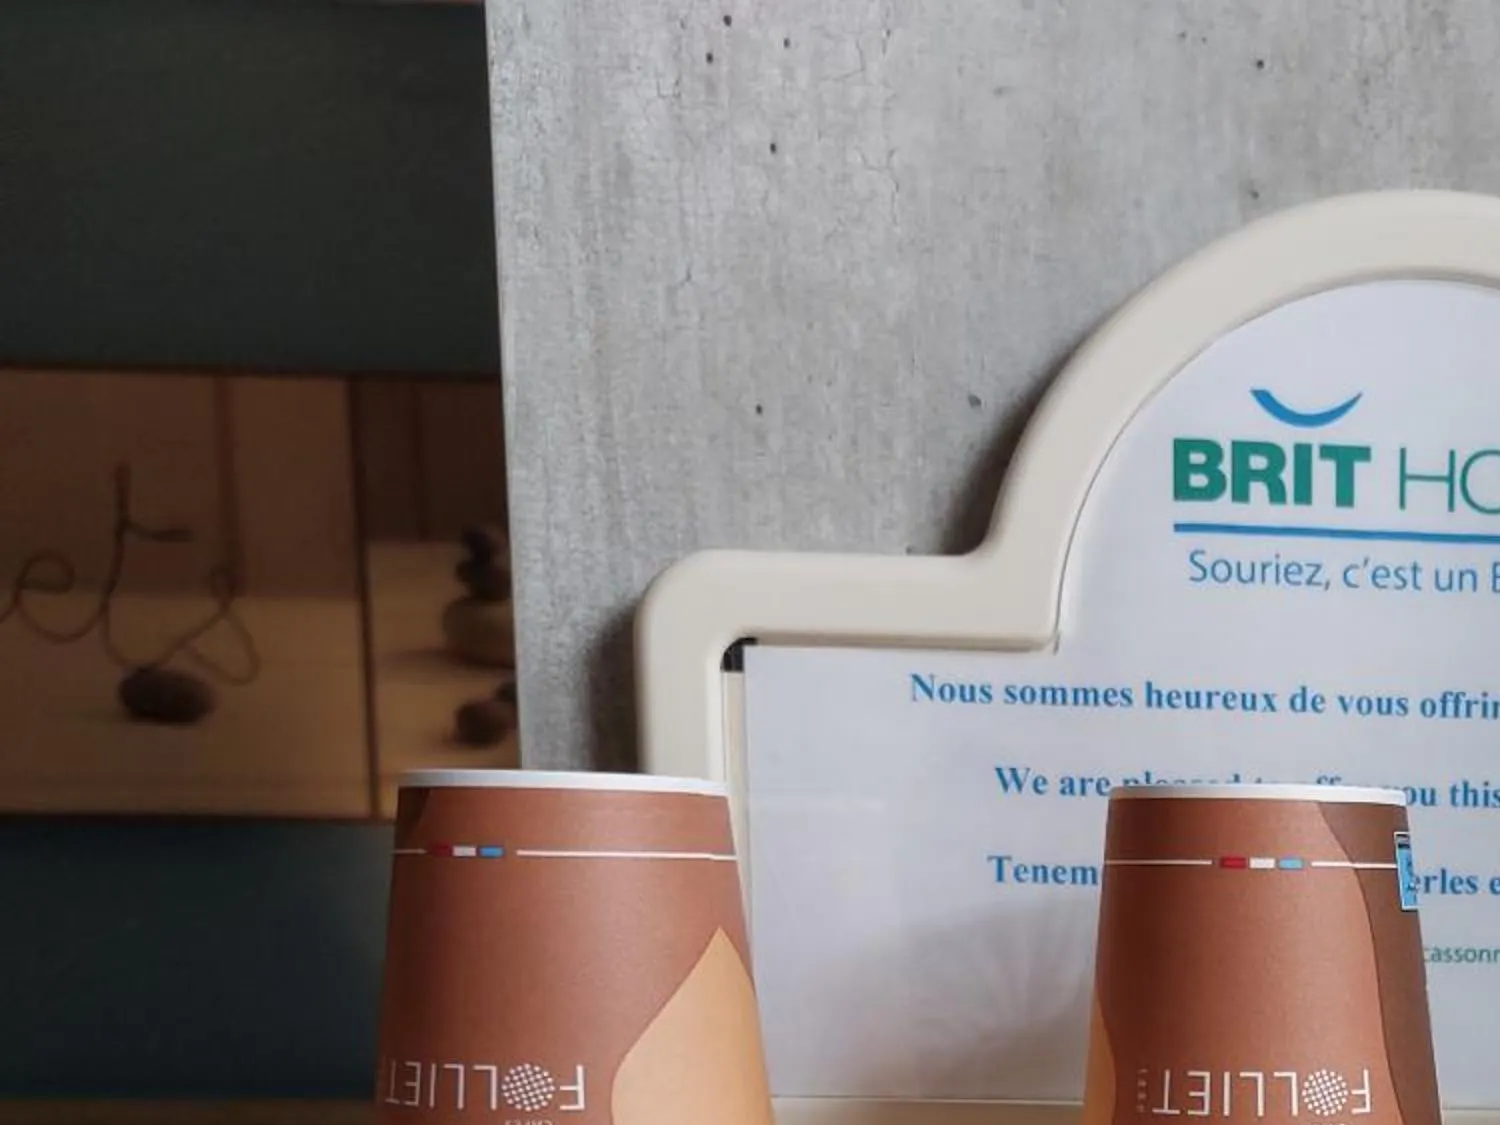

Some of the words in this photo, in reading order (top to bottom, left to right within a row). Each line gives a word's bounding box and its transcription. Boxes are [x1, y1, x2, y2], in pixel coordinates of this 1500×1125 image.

[1173, 438, 1371, 508] BRIT
[1188, 550, 1331, 591] Souriez,
[1434, 566, 1478, 592] un
[910, 673, 993, 704] Nous
[1004, 684, 1133, 708] sommes
[1145, 681, 1278, 713] heureux
[1289, 685, 1326, 713] de
[1337, 694, 1408, 717] vous
[995, 767, 1049, 796] We
[1060, 774, 1110, 797] are
[1404, 785, 1437, 808] ou
[988, 855, 1099, 886] Tenem
